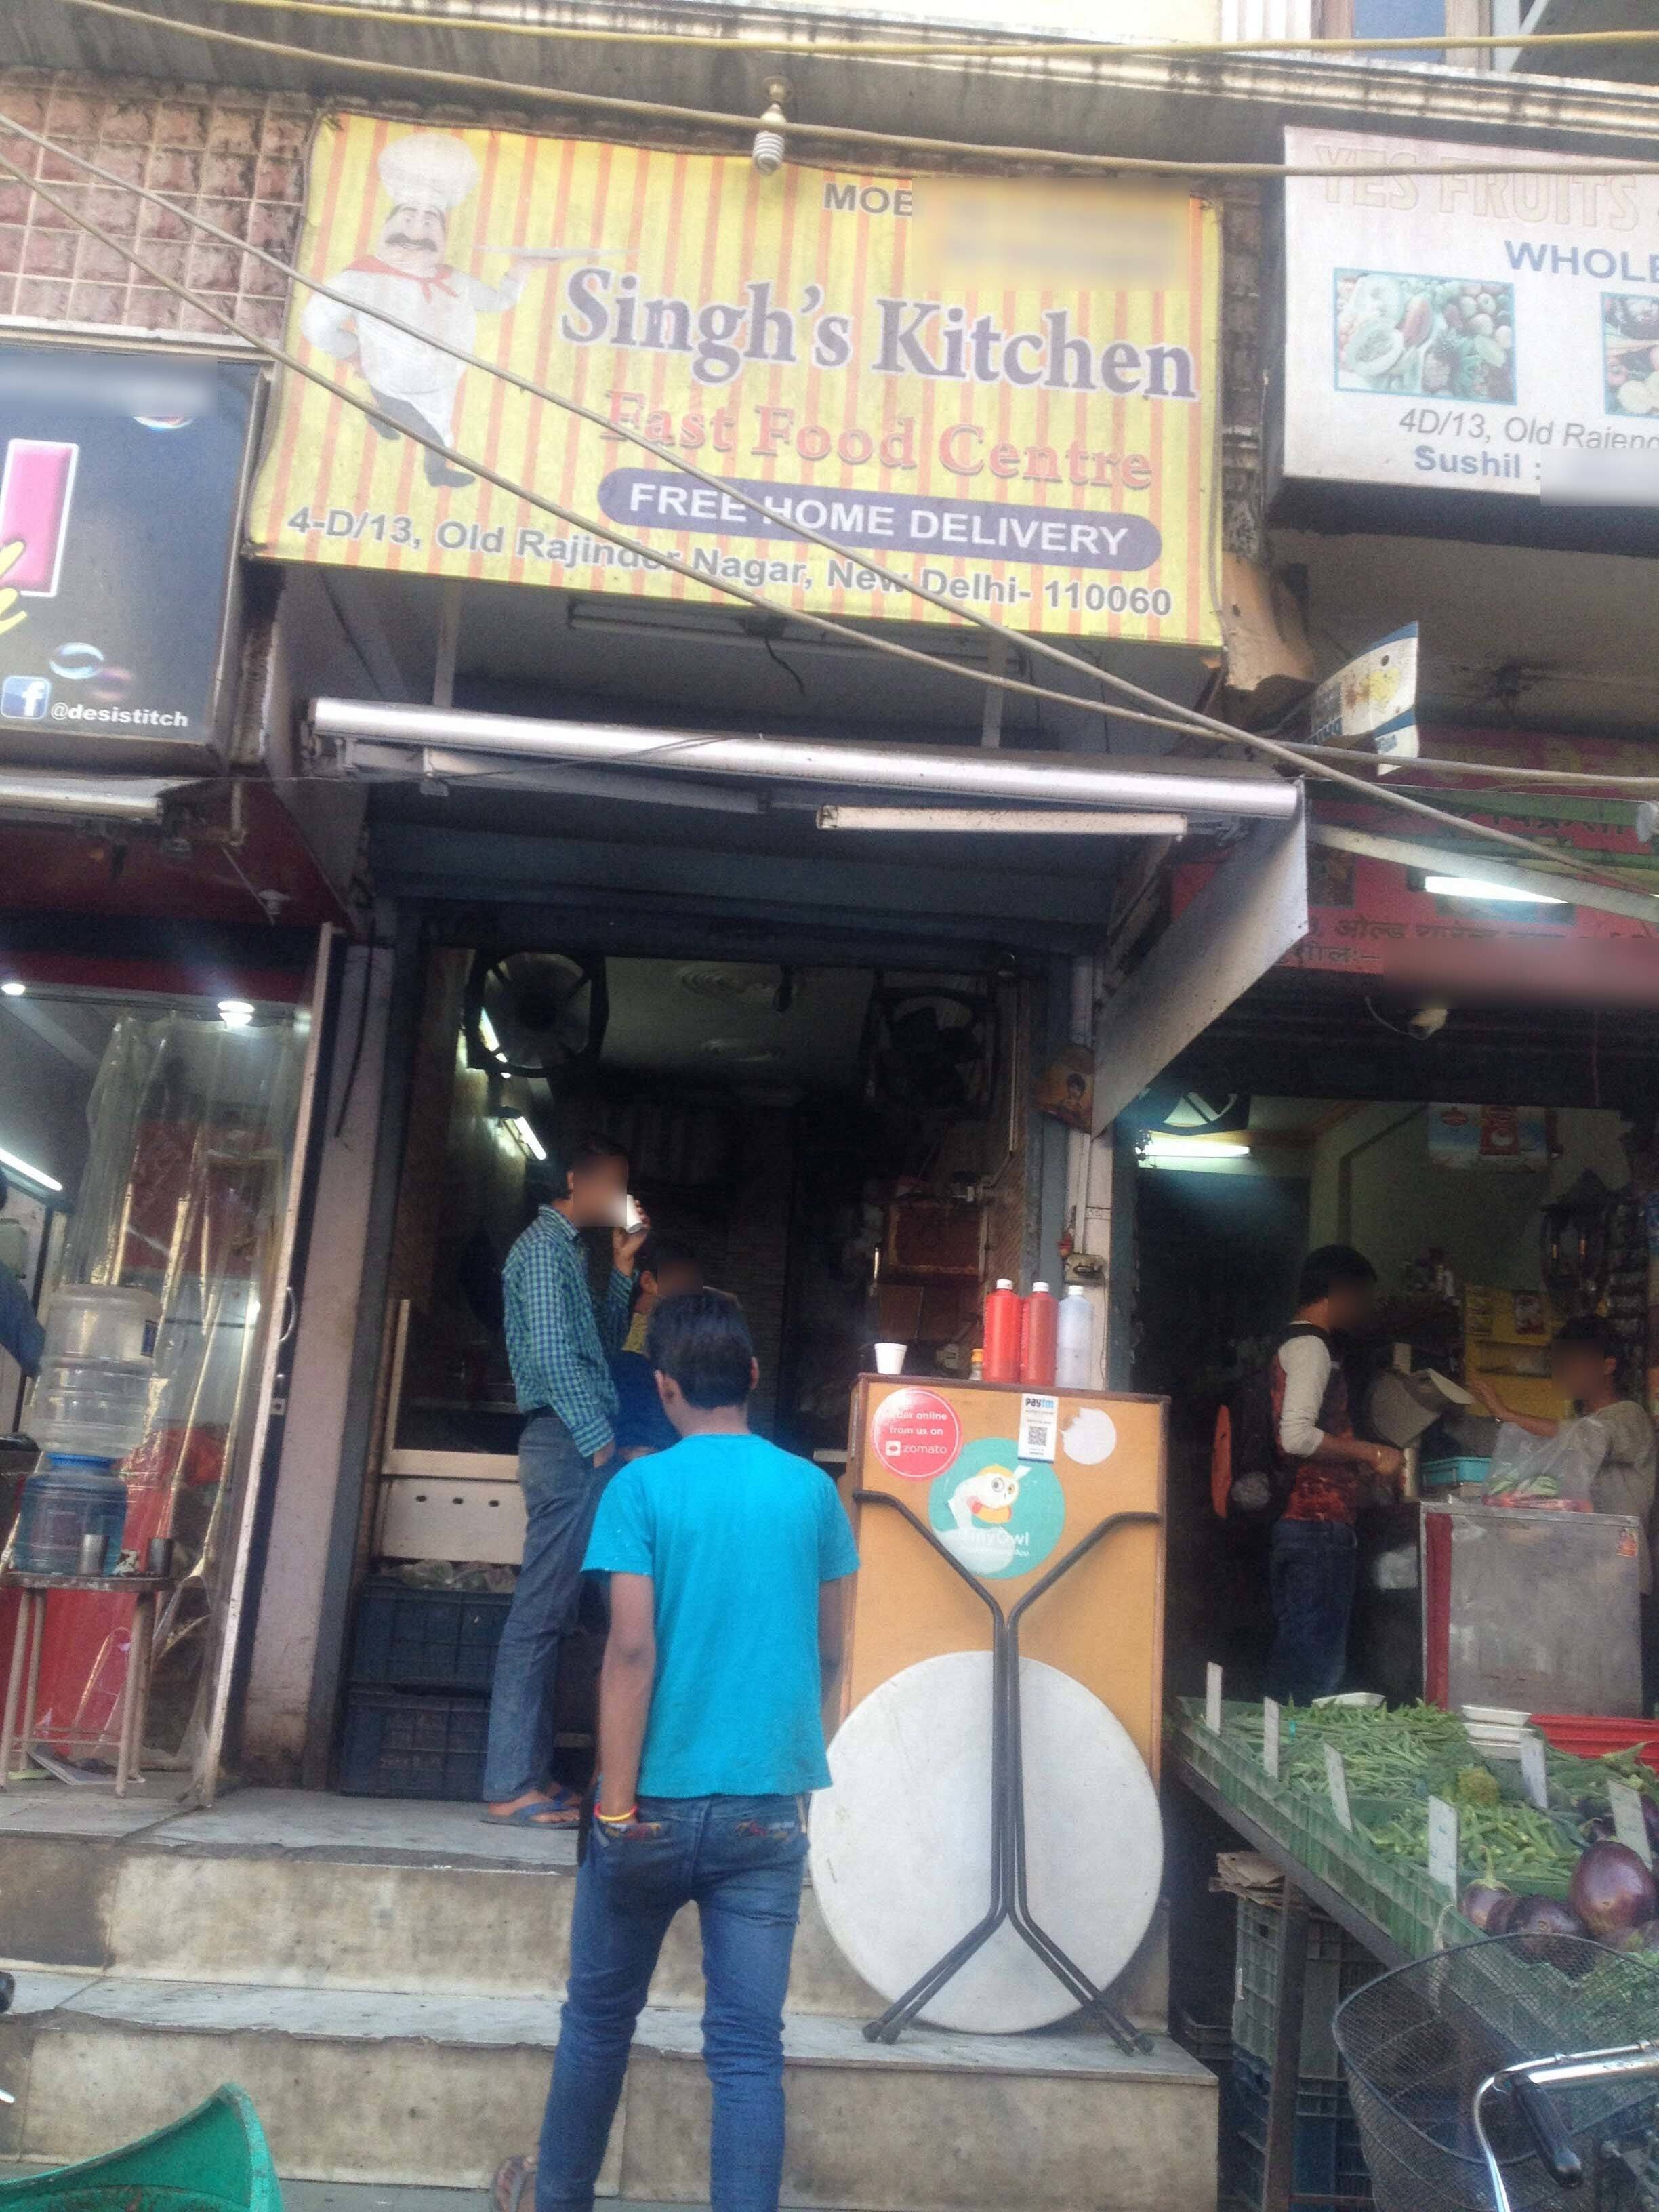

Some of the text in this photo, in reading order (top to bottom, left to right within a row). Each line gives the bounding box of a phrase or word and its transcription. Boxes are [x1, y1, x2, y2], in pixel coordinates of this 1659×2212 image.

[1315, 145, 1640, 232] YES FRUITS
[562, 268, 1197, 398] Singh's Kitchen
[600, 389, 1152, 491] Fast Food Centre
[1399, 408, 1491, 443] 4D/13,
[1504, 416, 1554, 445] Old
[1414, 445, 1521, 478] Sushil
[629, 482, 1128, 556] FREE HOME DELIVERY
[287, 506, 421, 549] 4-D/13,
[436, 520, 505, 554] Old
[693, 548, 812, 590] Nagar,
[921, 569, 1031, 603] Delhi-
[1044, 580, 1172, 615] 110060
[51, 702, 189, 727] @desistitch
[889, 1426, 914, 1435] from
[916, 1427, 928, 1435] us
[915, 1410, 948, 1420] online
[902, 1444, 948, 1454] zomato
